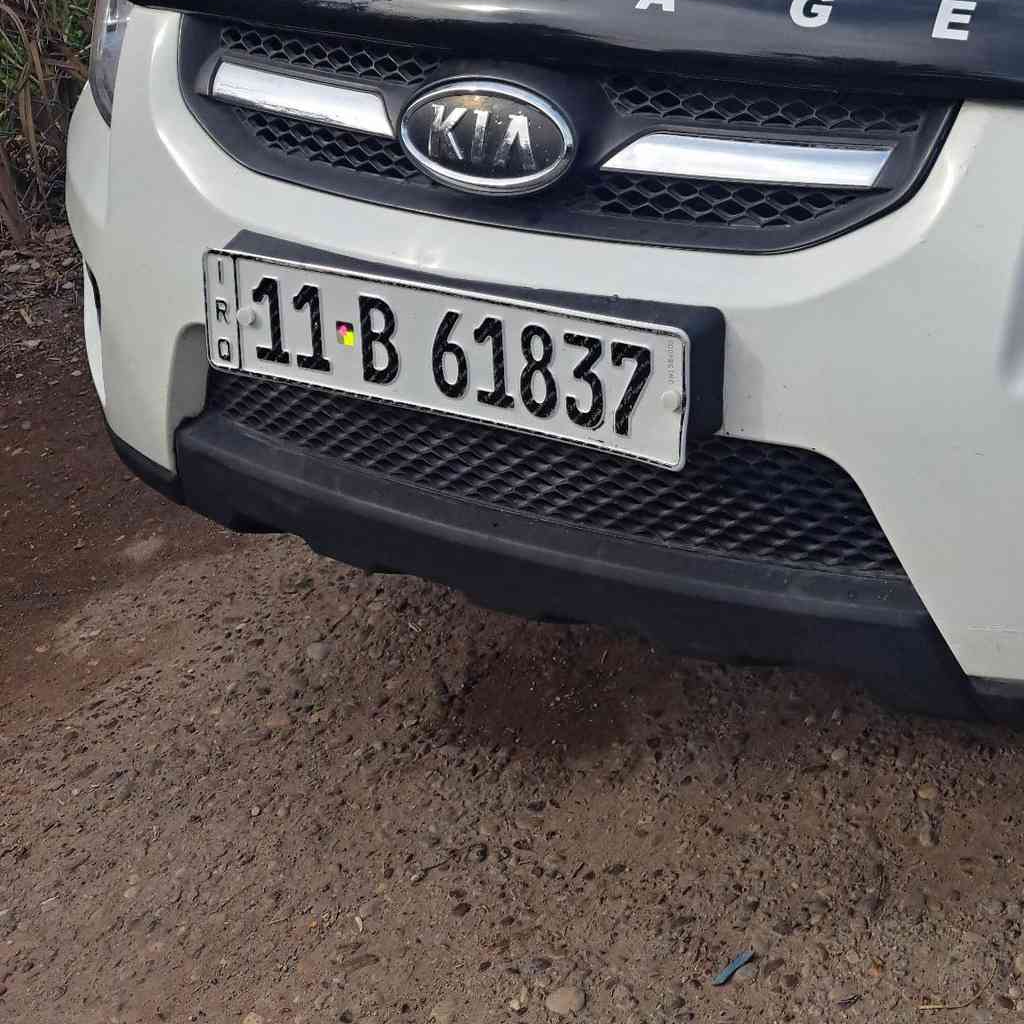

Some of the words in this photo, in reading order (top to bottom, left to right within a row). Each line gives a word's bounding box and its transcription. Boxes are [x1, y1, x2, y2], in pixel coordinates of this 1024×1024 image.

[427, 102, 538, 172] KIA
[251, 277, 331, 373] 11
[358, 294, 401, 385] B
[431, 310, 653, 439] 61837
